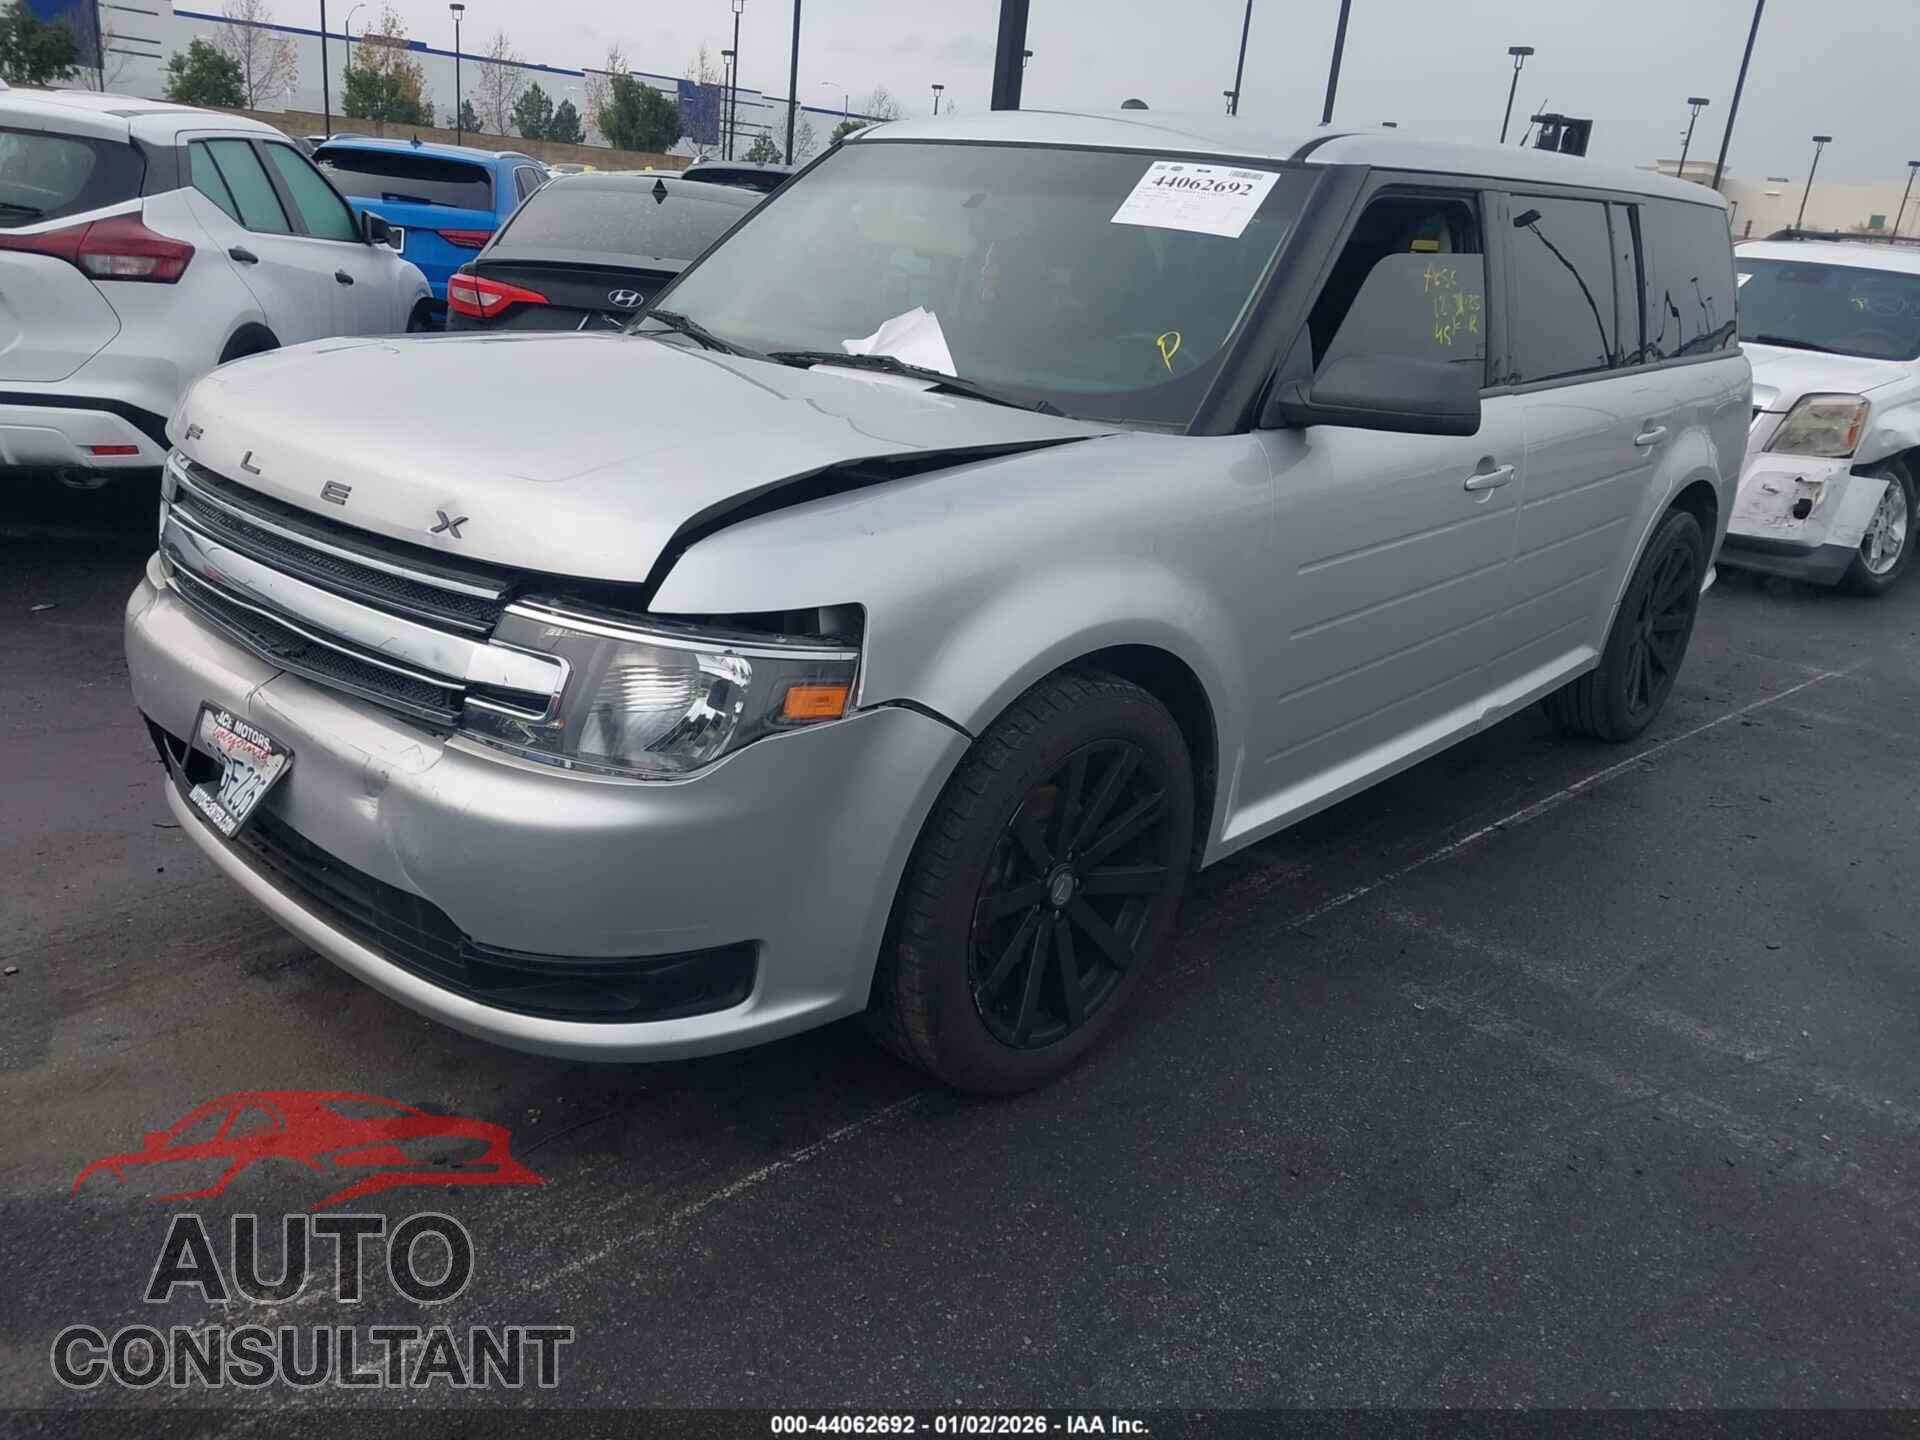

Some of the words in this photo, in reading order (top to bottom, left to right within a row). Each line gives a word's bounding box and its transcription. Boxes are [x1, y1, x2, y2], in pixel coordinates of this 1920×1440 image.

[1152, 174, 1253, 196] 44062692
[185, 423, 469, 540] FLEX
[233, 720, 271, 752] MOTORS
